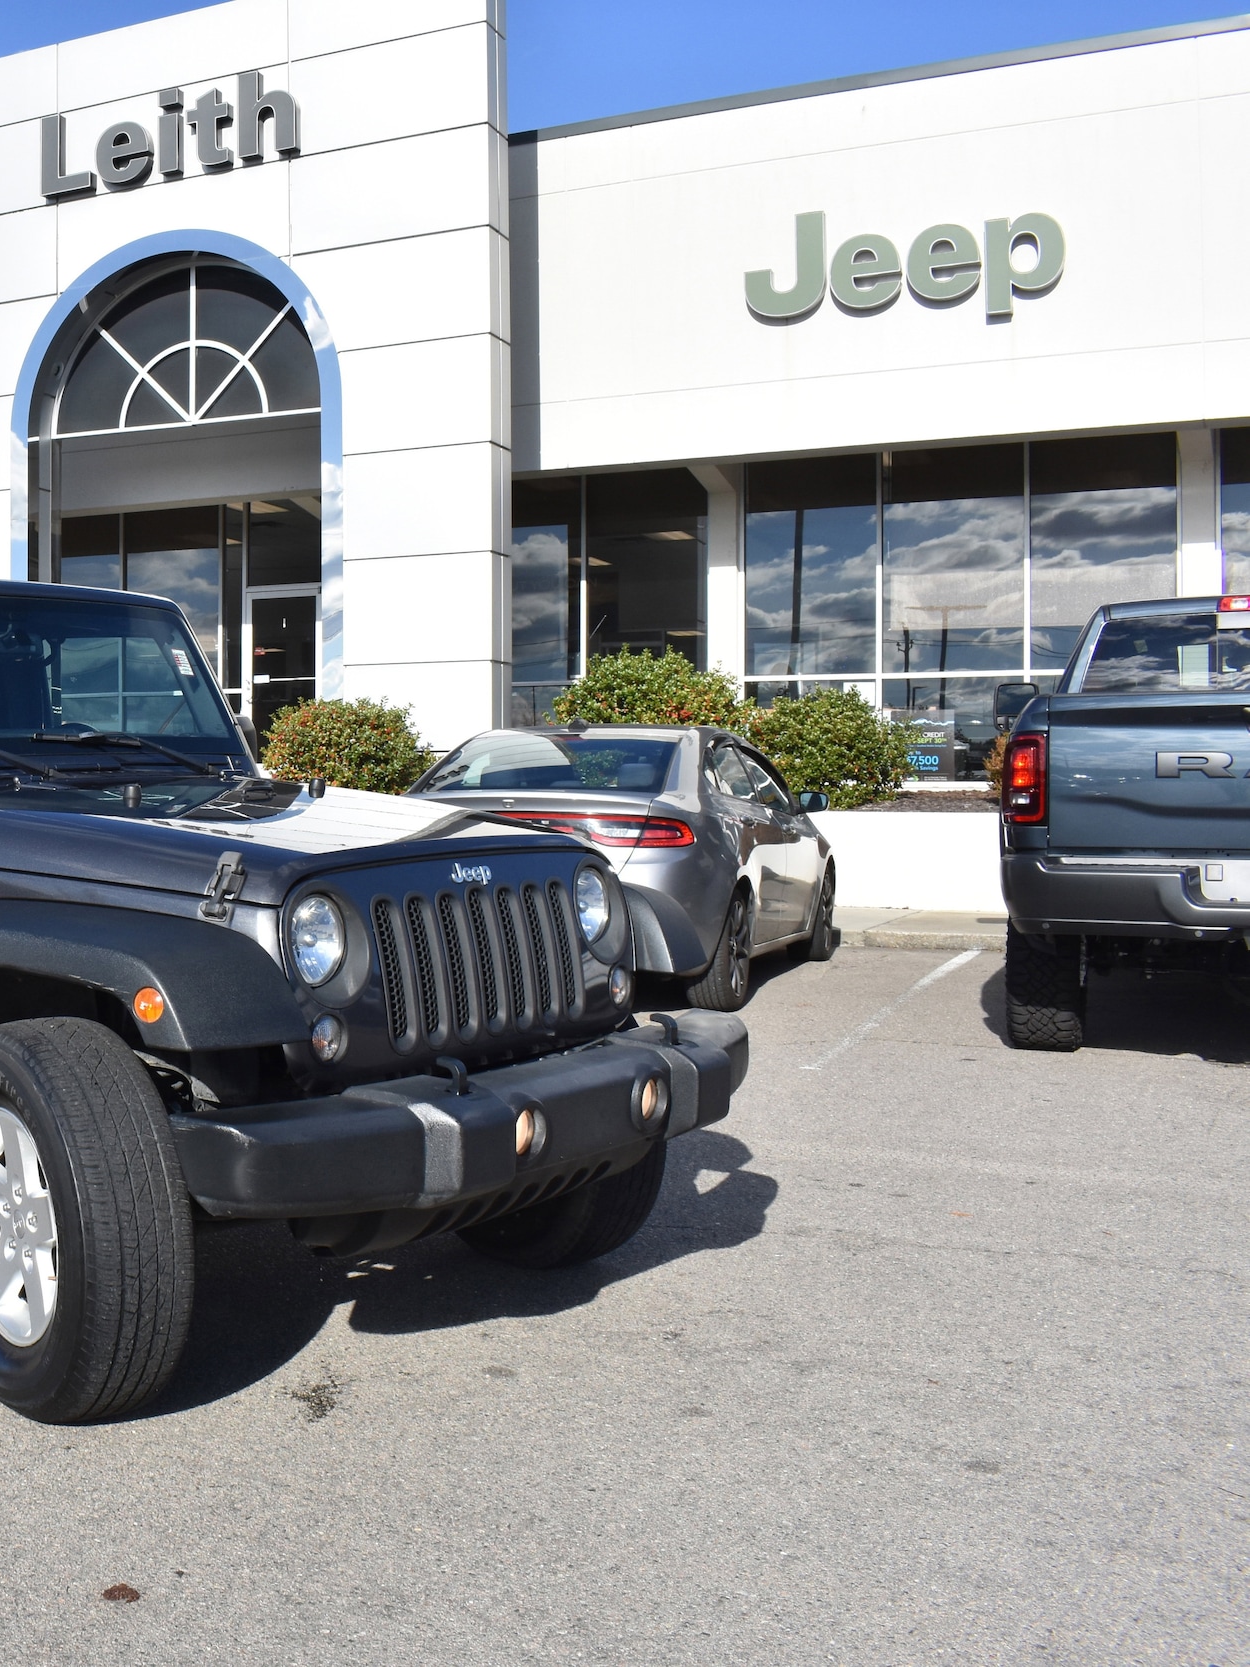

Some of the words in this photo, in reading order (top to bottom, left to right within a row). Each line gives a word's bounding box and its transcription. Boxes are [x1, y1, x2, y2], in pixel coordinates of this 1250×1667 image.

[40, 70, 301, 203] Leith
[743, 210, 1066, 324] Jeep
[1155, 751, 1250, 779] R
[450, 862, 492, 886] Jeep
